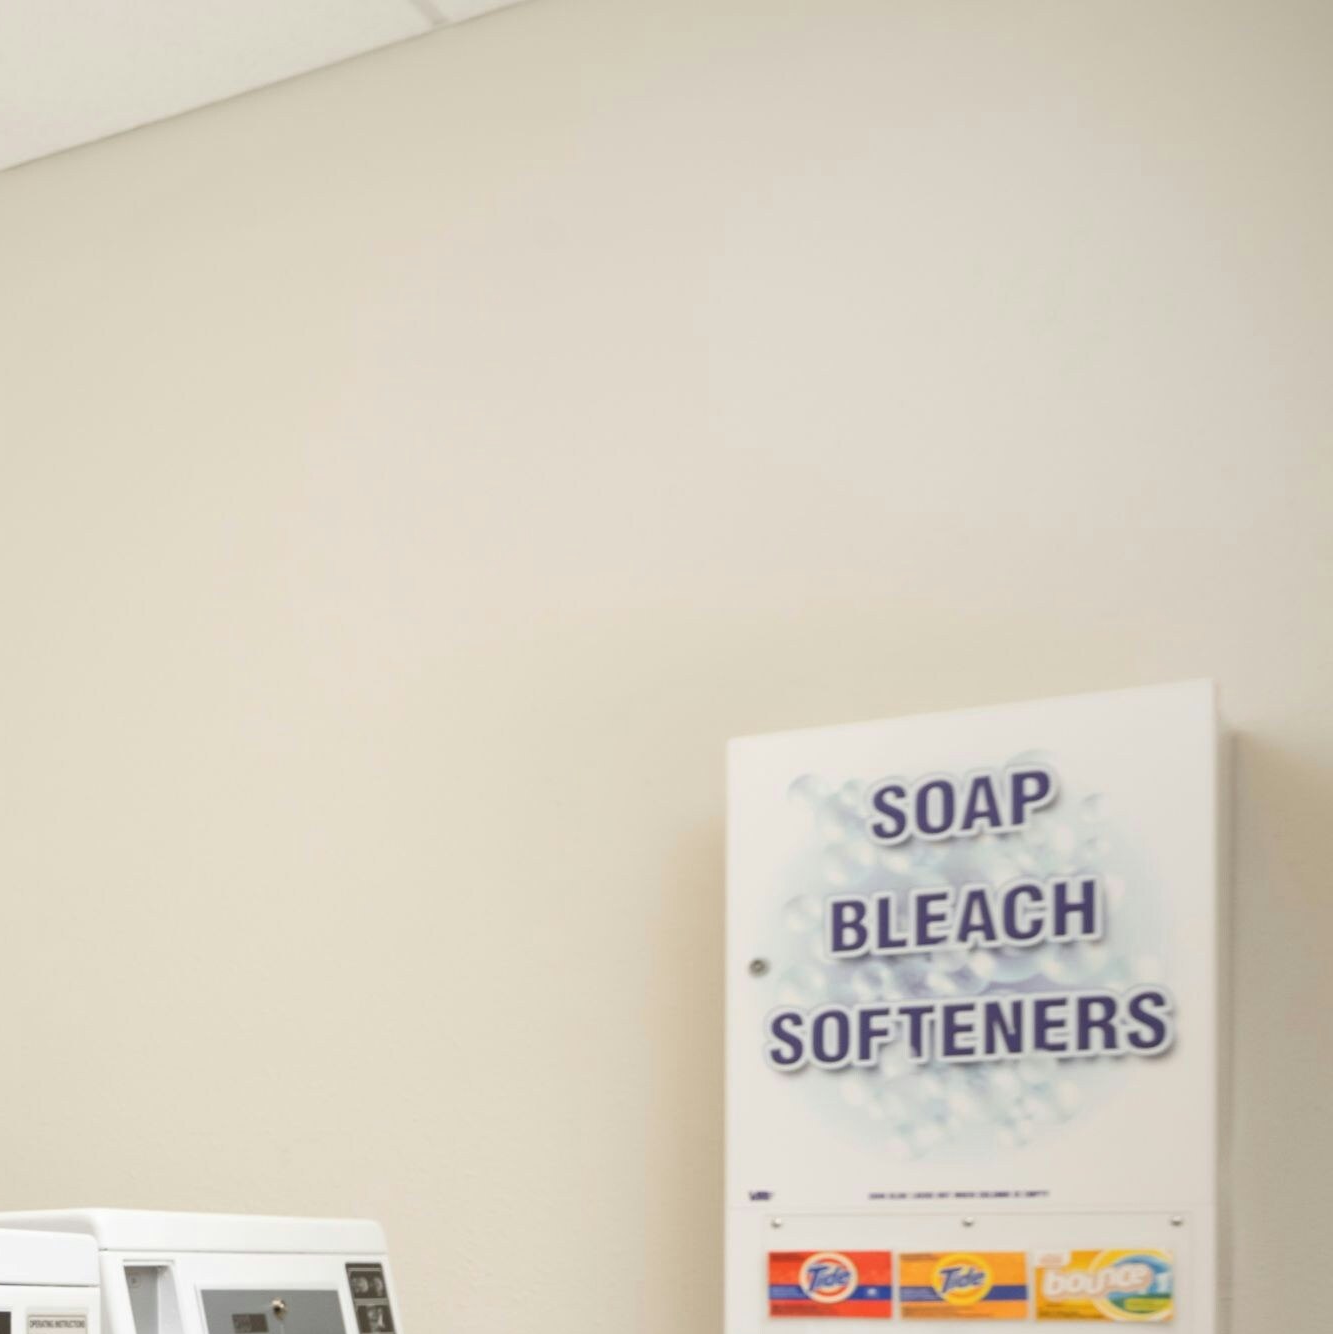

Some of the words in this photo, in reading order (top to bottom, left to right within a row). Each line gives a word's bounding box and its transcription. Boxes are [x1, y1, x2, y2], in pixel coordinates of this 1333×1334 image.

[871, 770, 1052, 840] SOAP
[831, 880, 1096, 953] BLEACH
[769, 992, 1167, 1065] SOFTENERS
[807, 1264, 851, 1291] Tide
[939, 1266, 984, 1293] Tide
